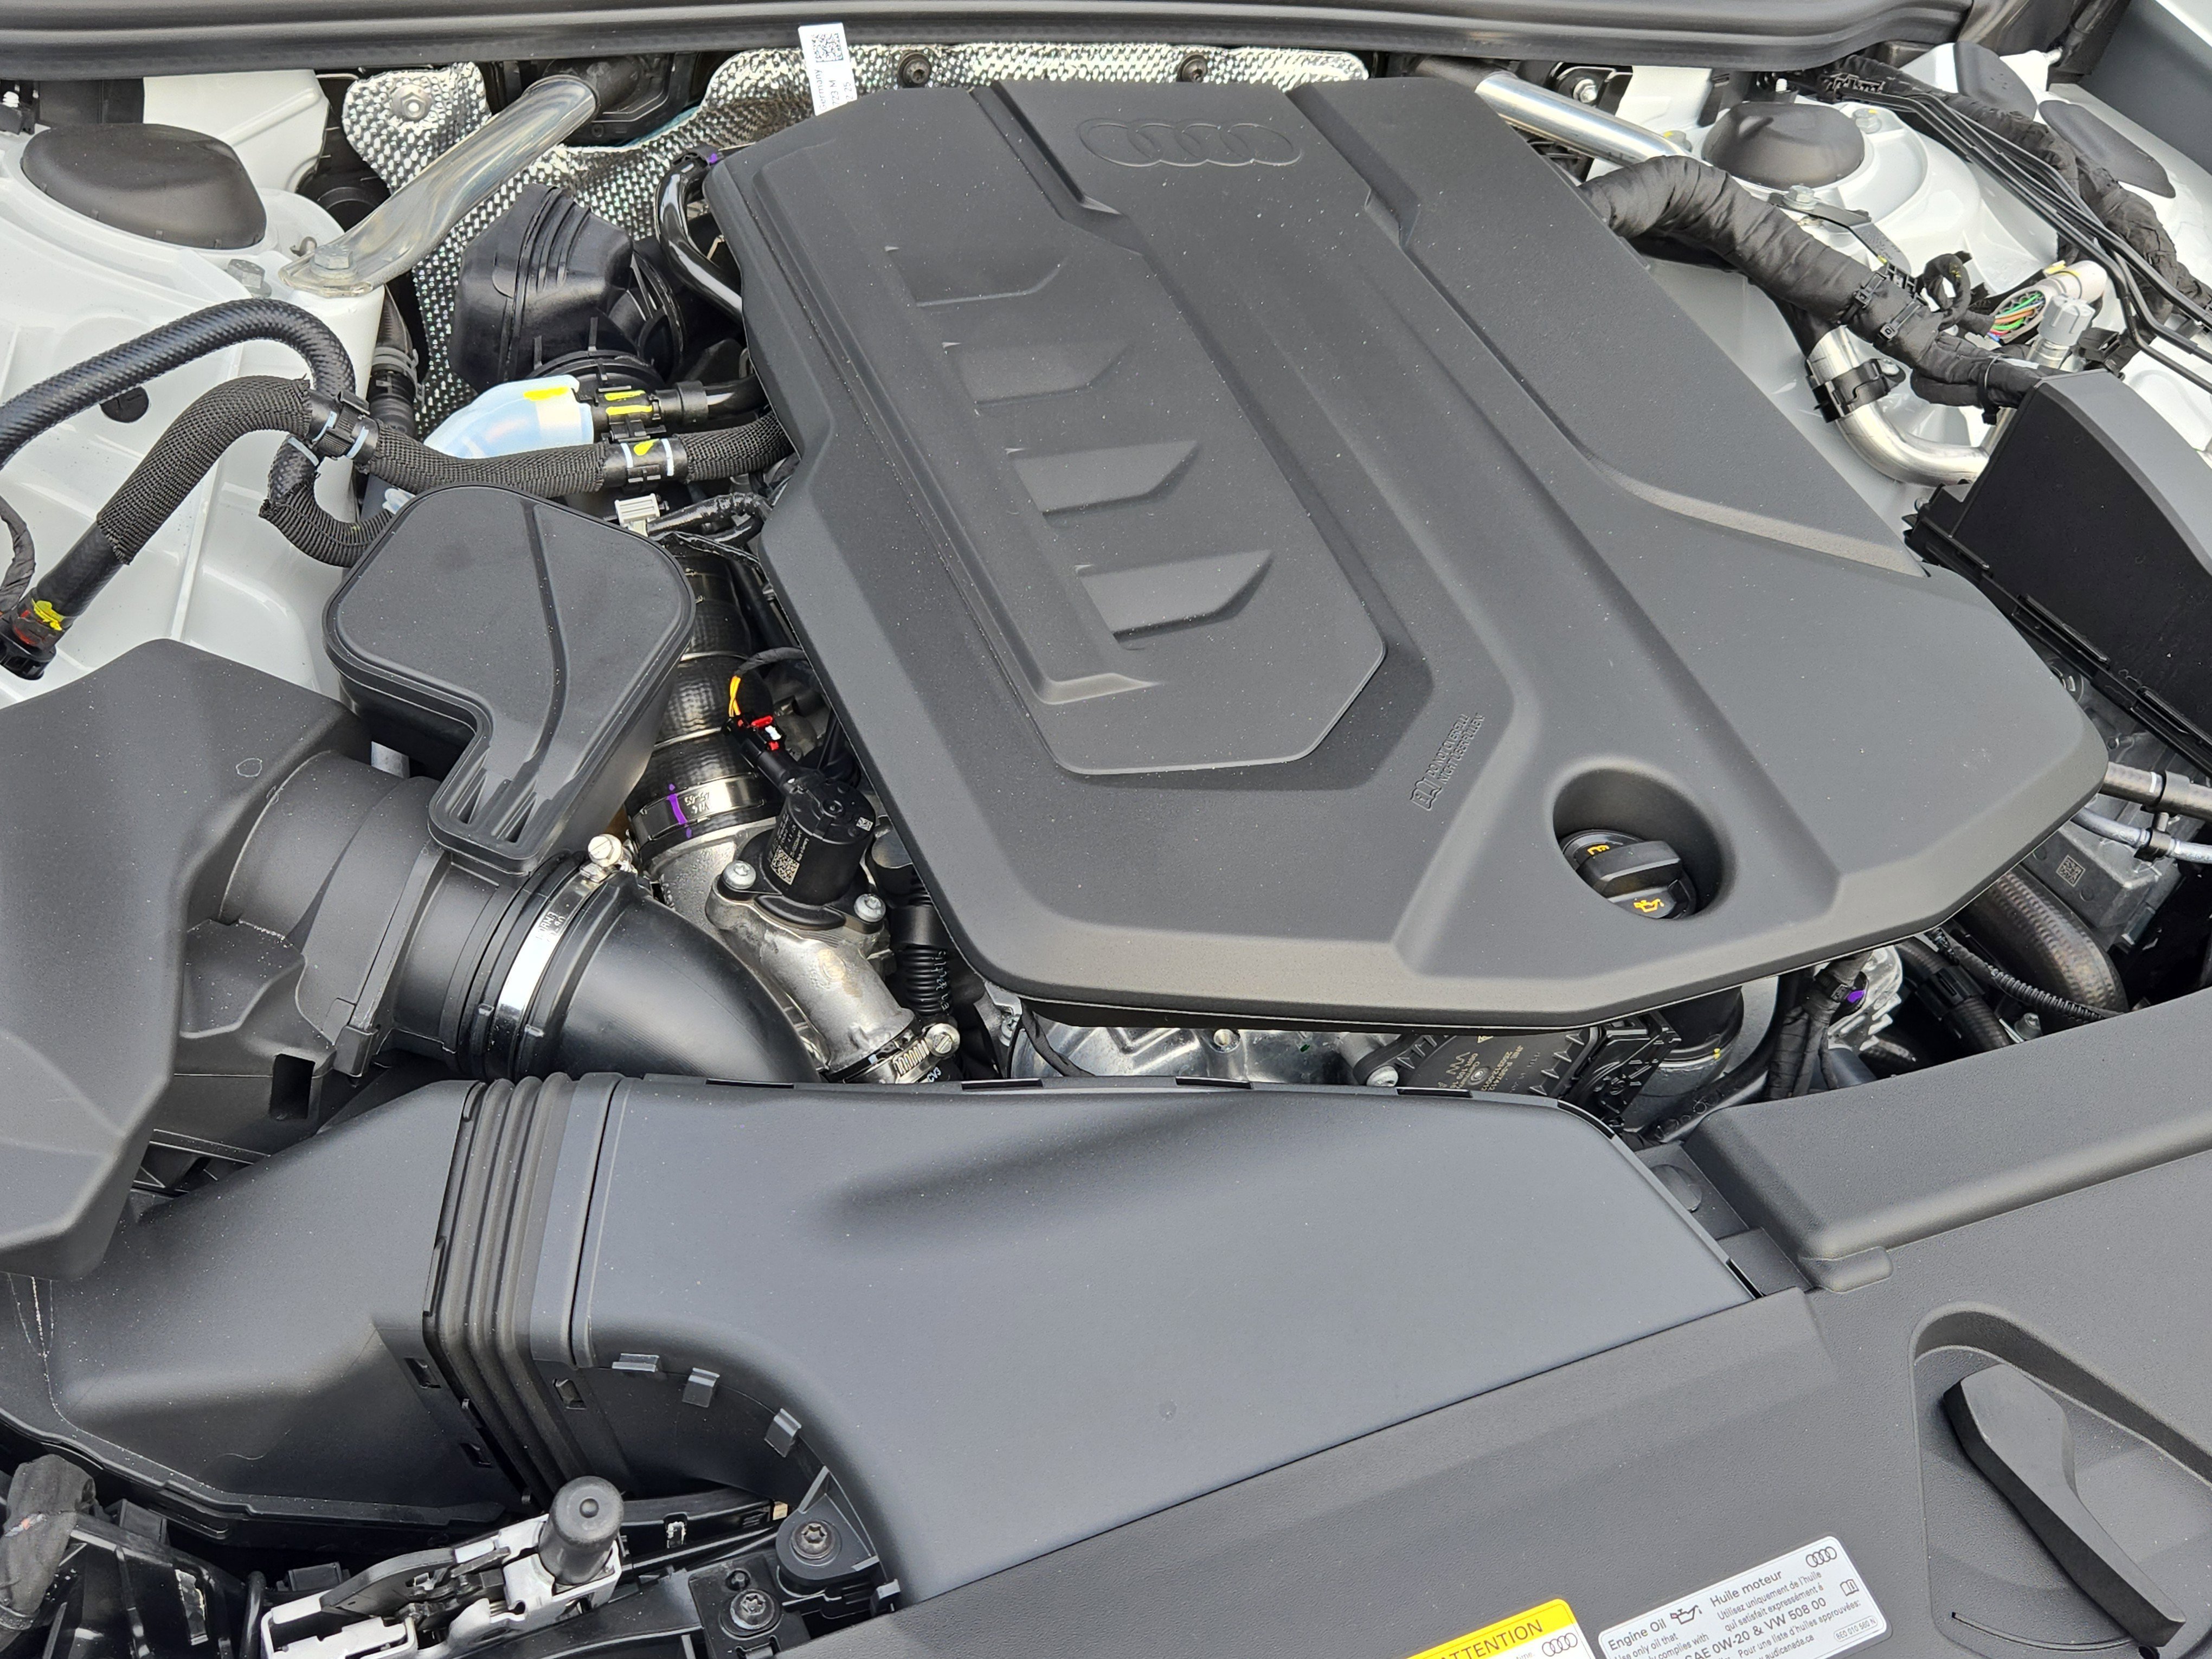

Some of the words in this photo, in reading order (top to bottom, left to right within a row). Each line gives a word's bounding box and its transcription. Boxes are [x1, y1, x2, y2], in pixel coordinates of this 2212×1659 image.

[815, 69, 827, 111] Germany
[828, 80, 837, 88] M
[1432, 747, 1450, 767] NOT
[1437, 757, 1459, 785] NICHT
[1709, 1589, 1740, 1607] Huile
[1741, 1571, 1783, 1594] moteur
[1716, 1604, 1745, 1621] Utilisez
[1746, 1584, 1789, 1609] uniquement
[1789, 1580, 1799, 1590] de
[1798, 1571, 1822, 1585] l'huile
[1712, 1631, 1750, 1654] 0W-20
[1752, 1625, 1764, 1636] &
[1764, 1613, 1786, 1630] VW
[1788, 1604, 1810, 1621] 508
[1811, 1597, 1827, 1610] 00
[1725, 1618, 1738, 1632] qui
[1738, 1606, 1768, 1624] satisfait
[1768, 1586, 1818, 1613] expressément
[1441, 1619, 1543, 1659] TTENTION
[1608, 1628, 1648, 1651] Engine
[1650, 1618, 1667, 1632] Oil
[1633, 1644, 1650, 1657] only
[1651, 1638, 1661, 1649] oil
[1661, 1632, 1679, 1645] that
[1658, 1641, 1692, 1659] complies
[1692, 1632, 1709, 1645] with
[1738, 1645, 1757, 1659] Pour
[1757, 1639, 1772, 1650] une
[1772, 1632, 1789, 1643] liste
[1789, 1619, 1818, 1636] d'huiles
[1818, 1599, 1861, 1623] approuvées:
